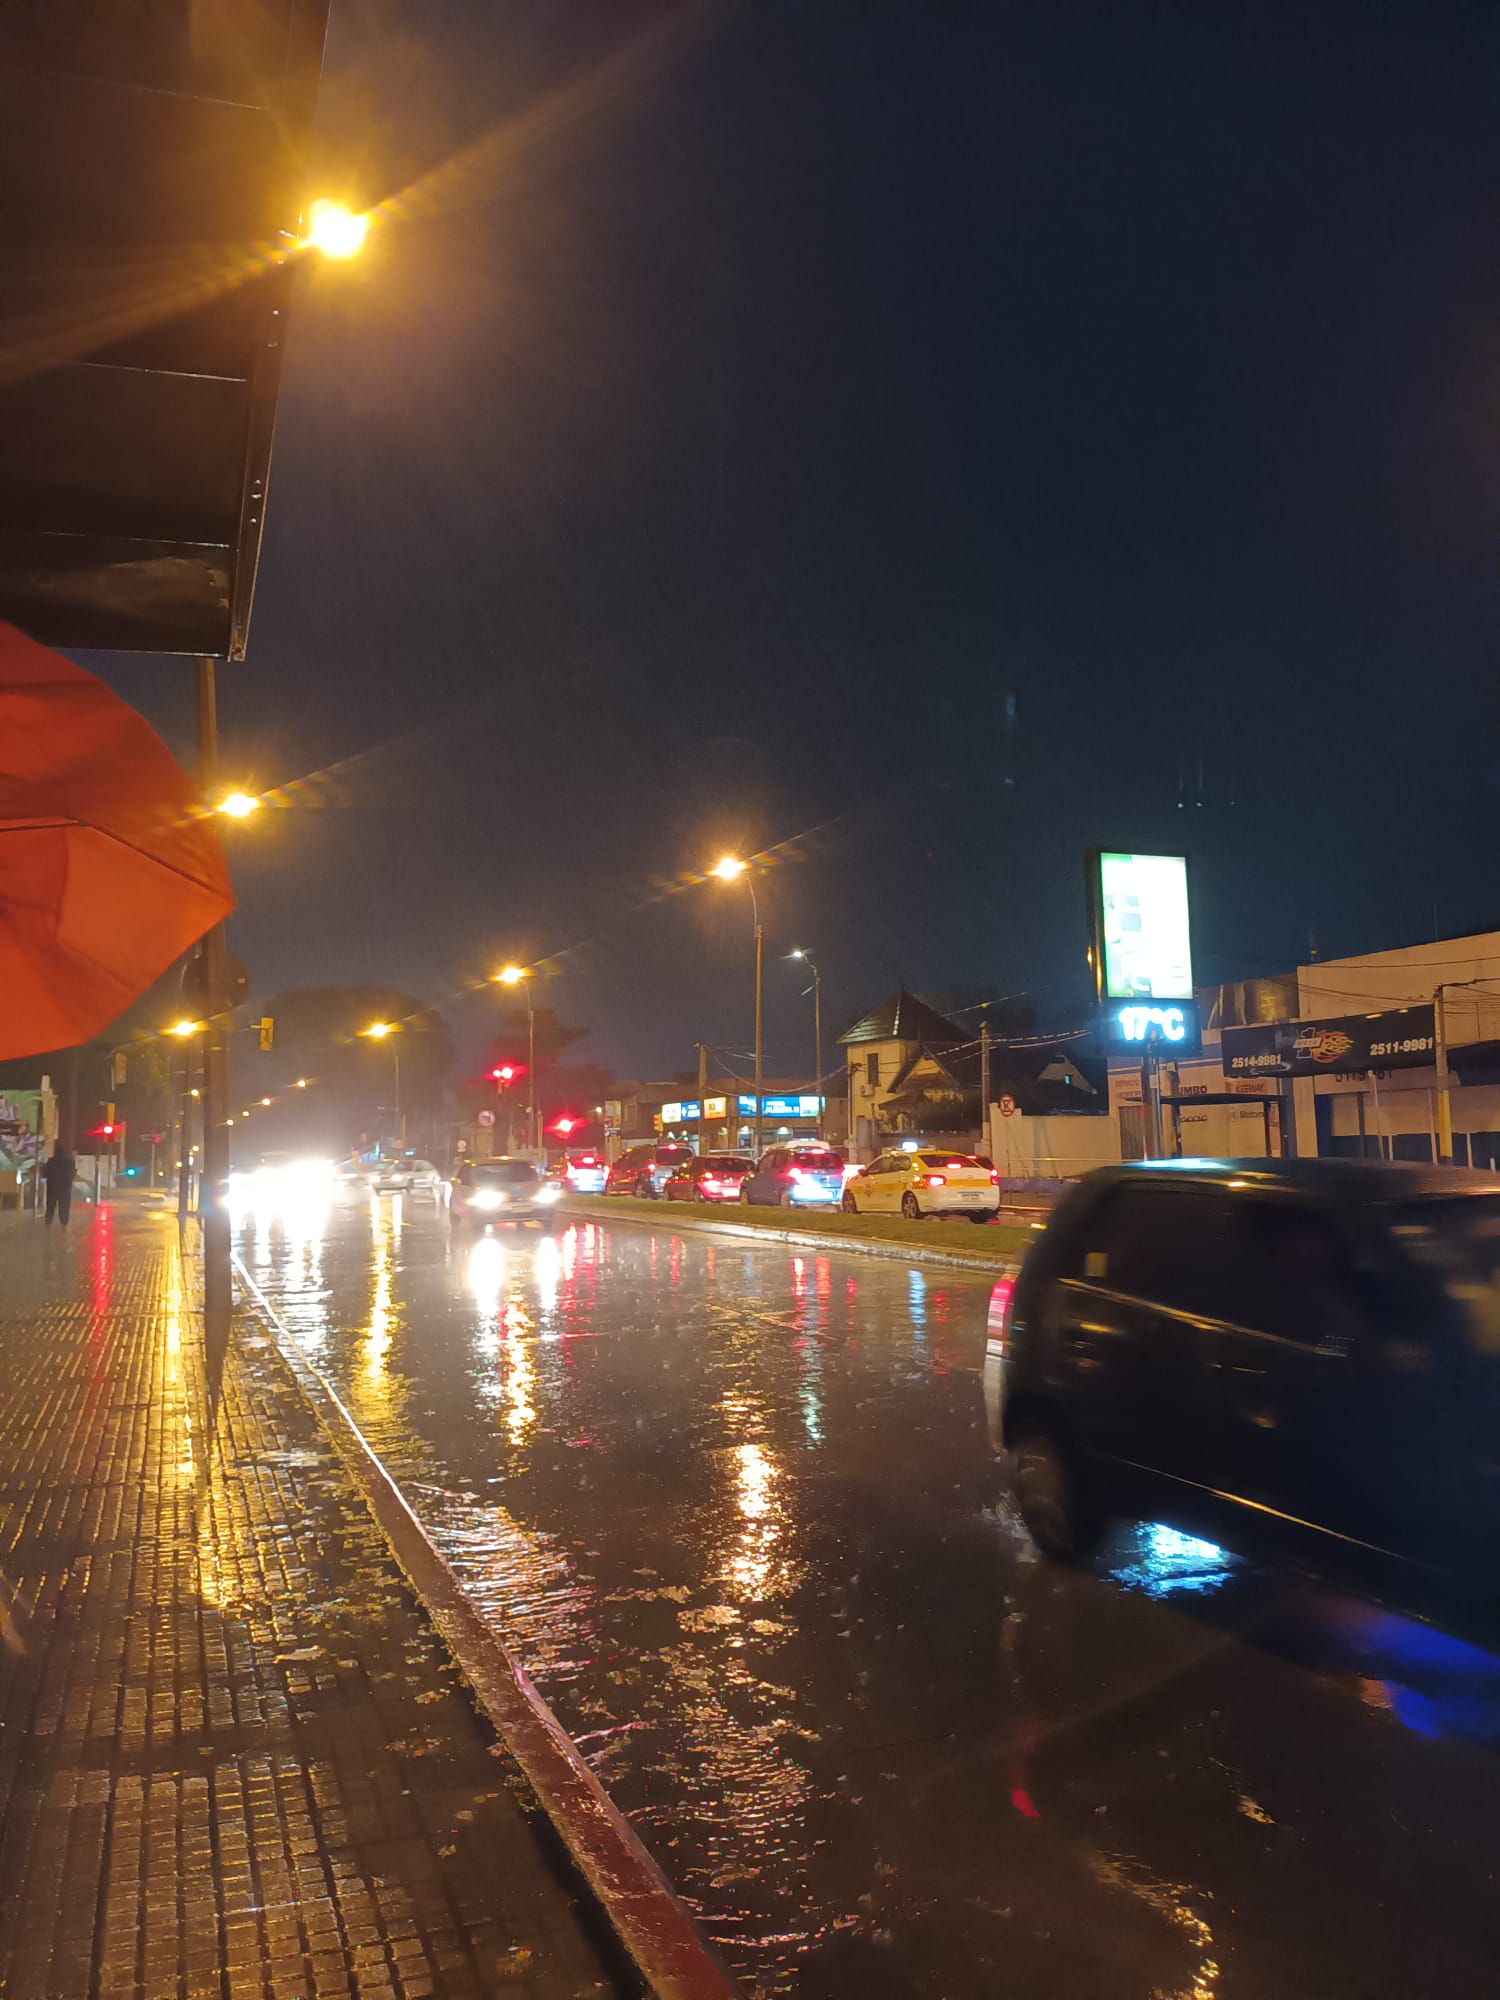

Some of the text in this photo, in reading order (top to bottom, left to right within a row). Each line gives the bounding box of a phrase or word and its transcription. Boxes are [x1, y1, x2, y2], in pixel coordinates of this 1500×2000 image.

[1369, 1037, 1434, 1056] 2511-9981
[1231, 1053, 1282, 1069] 2514-9981
[1177, 1085, 1208, 1095] UMBO
